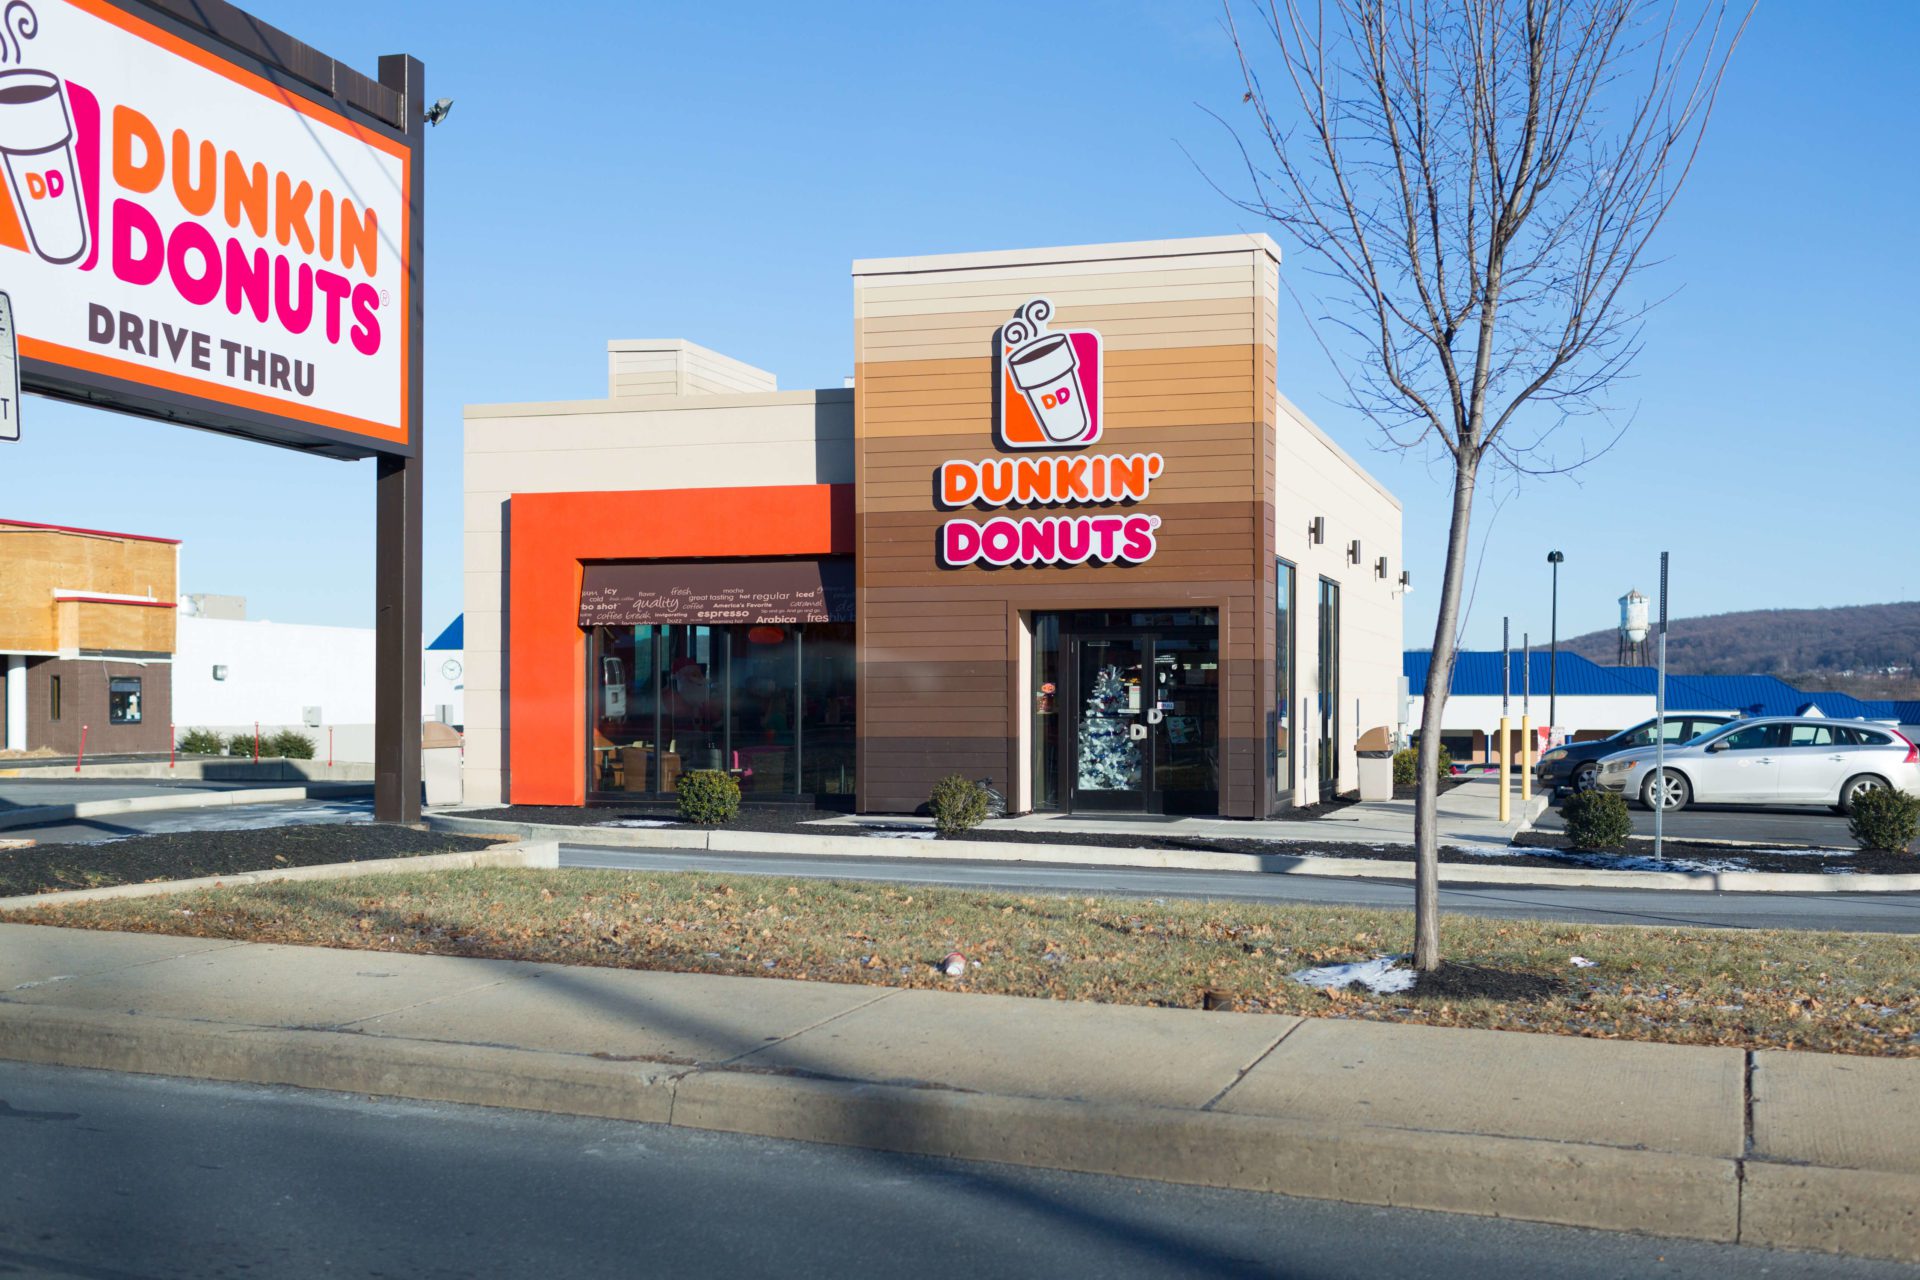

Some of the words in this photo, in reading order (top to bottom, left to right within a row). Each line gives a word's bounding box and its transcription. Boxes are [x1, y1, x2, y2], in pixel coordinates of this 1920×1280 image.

[25, 169, 64, 200] DD
[112, 104, 377, 278] DUNKIN
[112, 198, 381, 356] DONUTS
[88, 302, 211, 372] DRIVE
[220, 338, 315, 397] THRU
[1041, 387, 1070, 410] DD
[944, 456, 1161, 503] DUNKIN'
[946, 517, 1153, 562] DONUTS
[671, 586, 692, 596] fresh
[688, 594, 708, 602] great
[709, 594, 734, 602] tasting
[752, 592, 790, 602] regular
[632, 595, 679, 613] quality
[682, 602, 704, 610] coffee
[596, 611, 623, 620] coffee
[625, 610, 652, 620] break
[697, 610, 750, 620] espresso
[755, 615, 797, 624] Arabica
